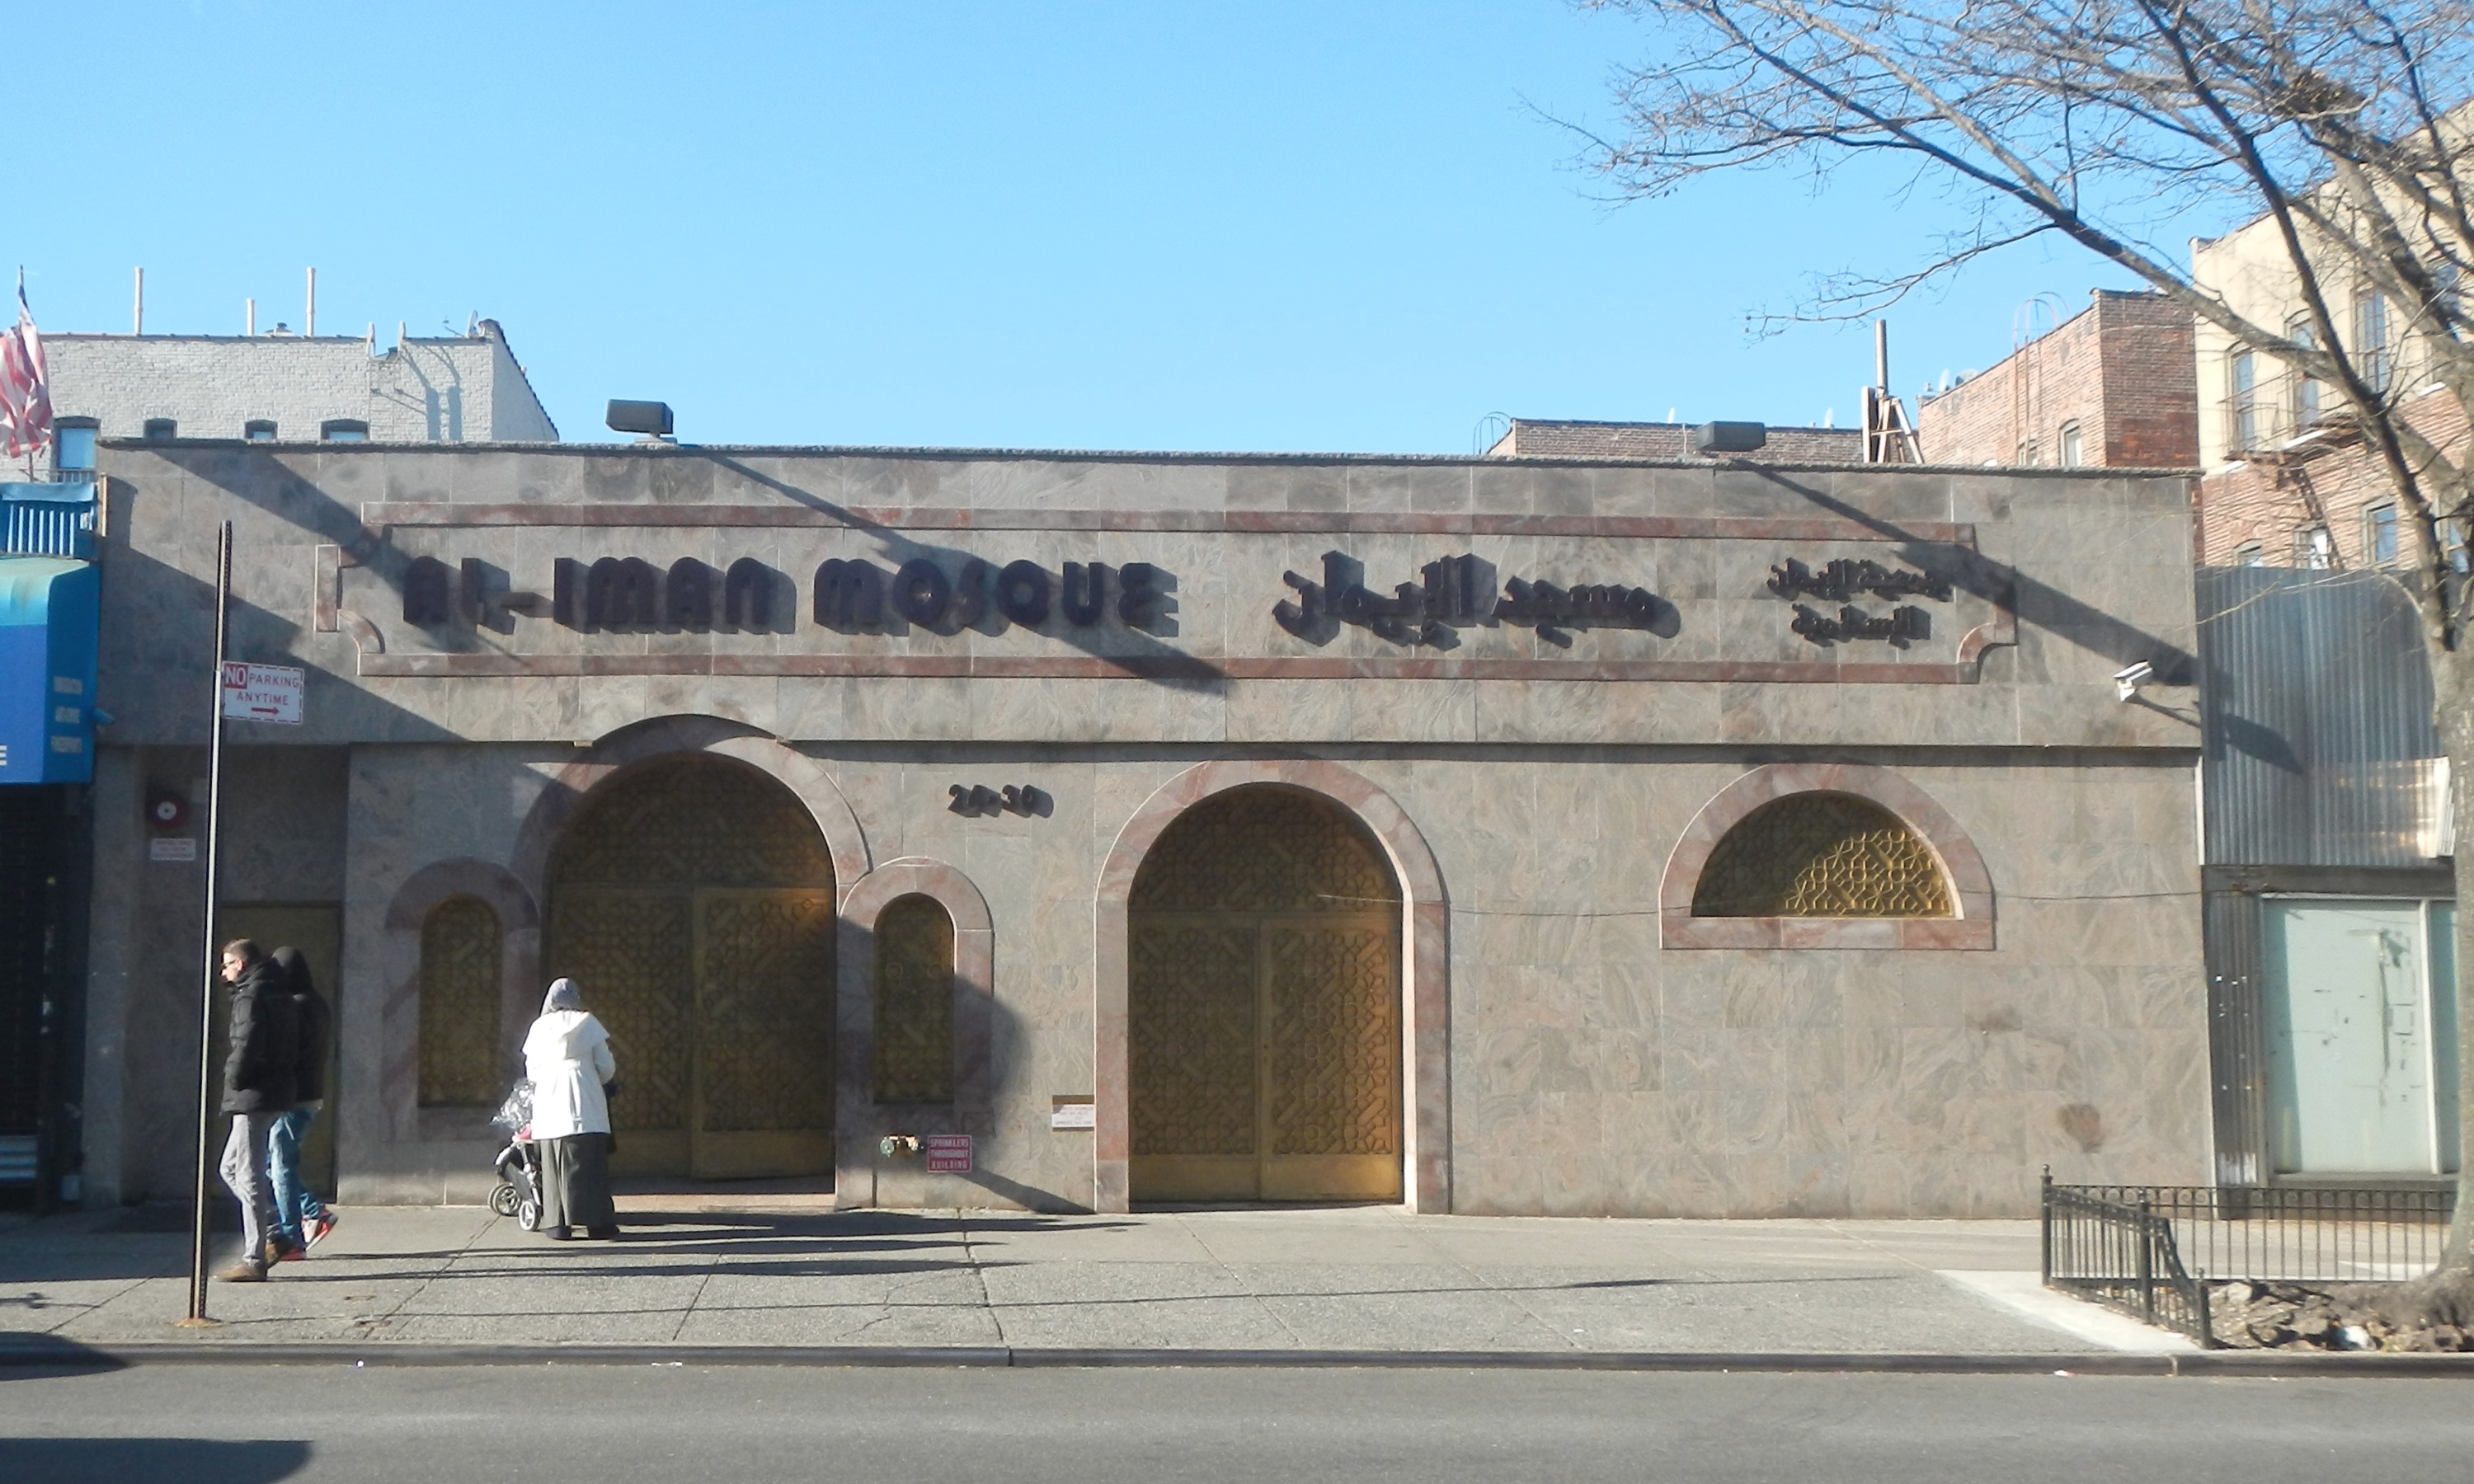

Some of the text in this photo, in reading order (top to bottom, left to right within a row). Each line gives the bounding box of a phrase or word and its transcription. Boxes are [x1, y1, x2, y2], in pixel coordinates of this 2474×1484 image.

[814, 558, 1156, 629] MOSQUE
[225, 666, 299, 688] NO PARKING
[236, 691, 289, 706] ANYTIME
[929, 1138, 969, 1148] SPRINKLERS
[931, 1160, 968, 1169] BUILDING
